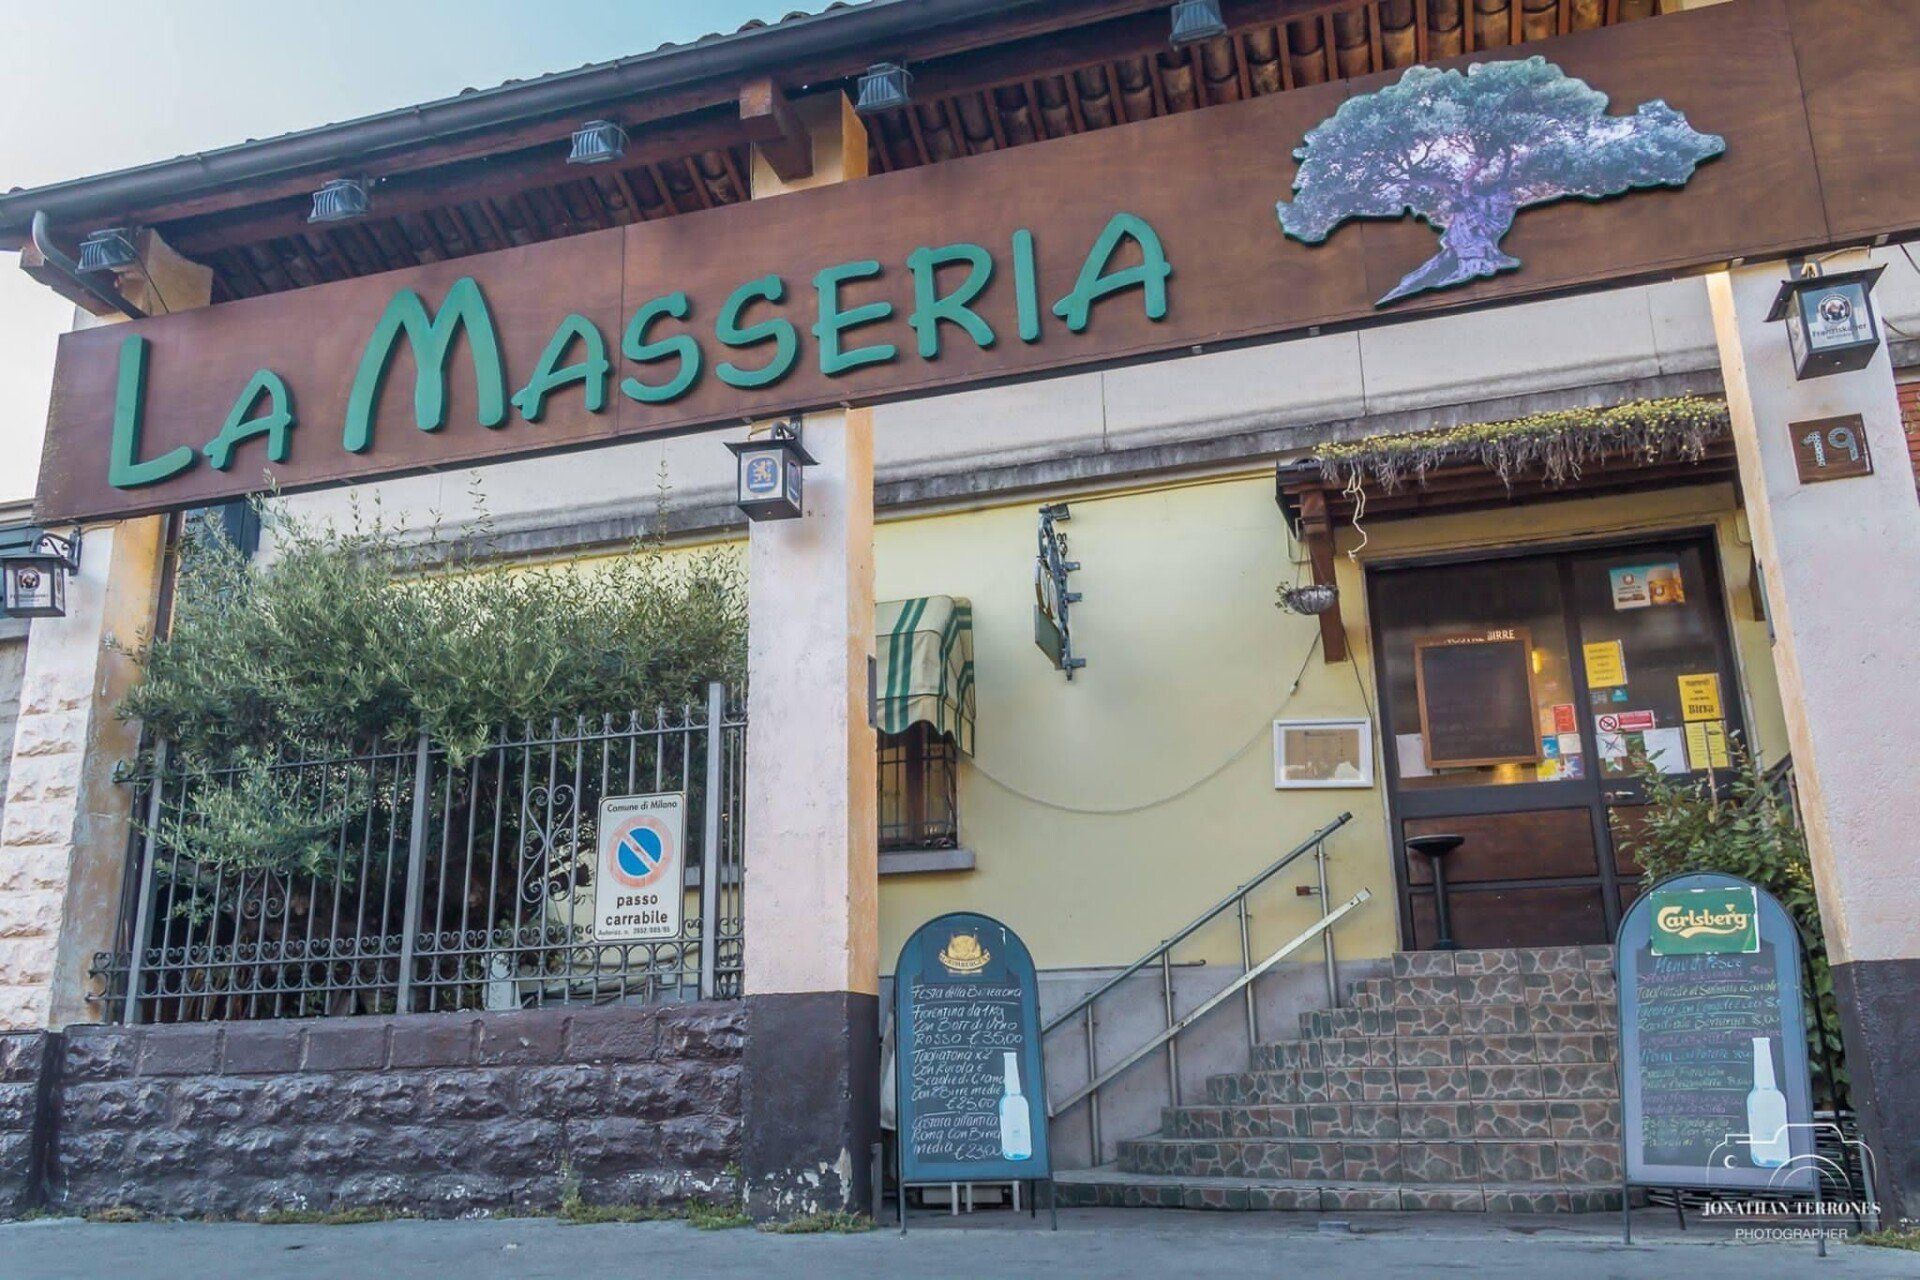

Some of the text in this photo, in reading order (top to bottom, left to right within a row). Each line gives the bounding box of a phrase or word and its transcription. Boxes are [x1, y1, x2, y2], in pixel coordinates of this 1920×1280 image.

[108, 213, 1172, 488] LA MASSERIA
[1801, 427, 1859, 468] 19
[607, 800, 678, 813] Comune di Milano
[616, 894, 658, 908] passo
[605, 911, 668, 926] carrabile
[1657, 904, 1748, 938] Carlsberg
[911, 985, 943, 999] Festa
[944, 985, 966, 999] della
[967, 1003, 980, 1017] da
